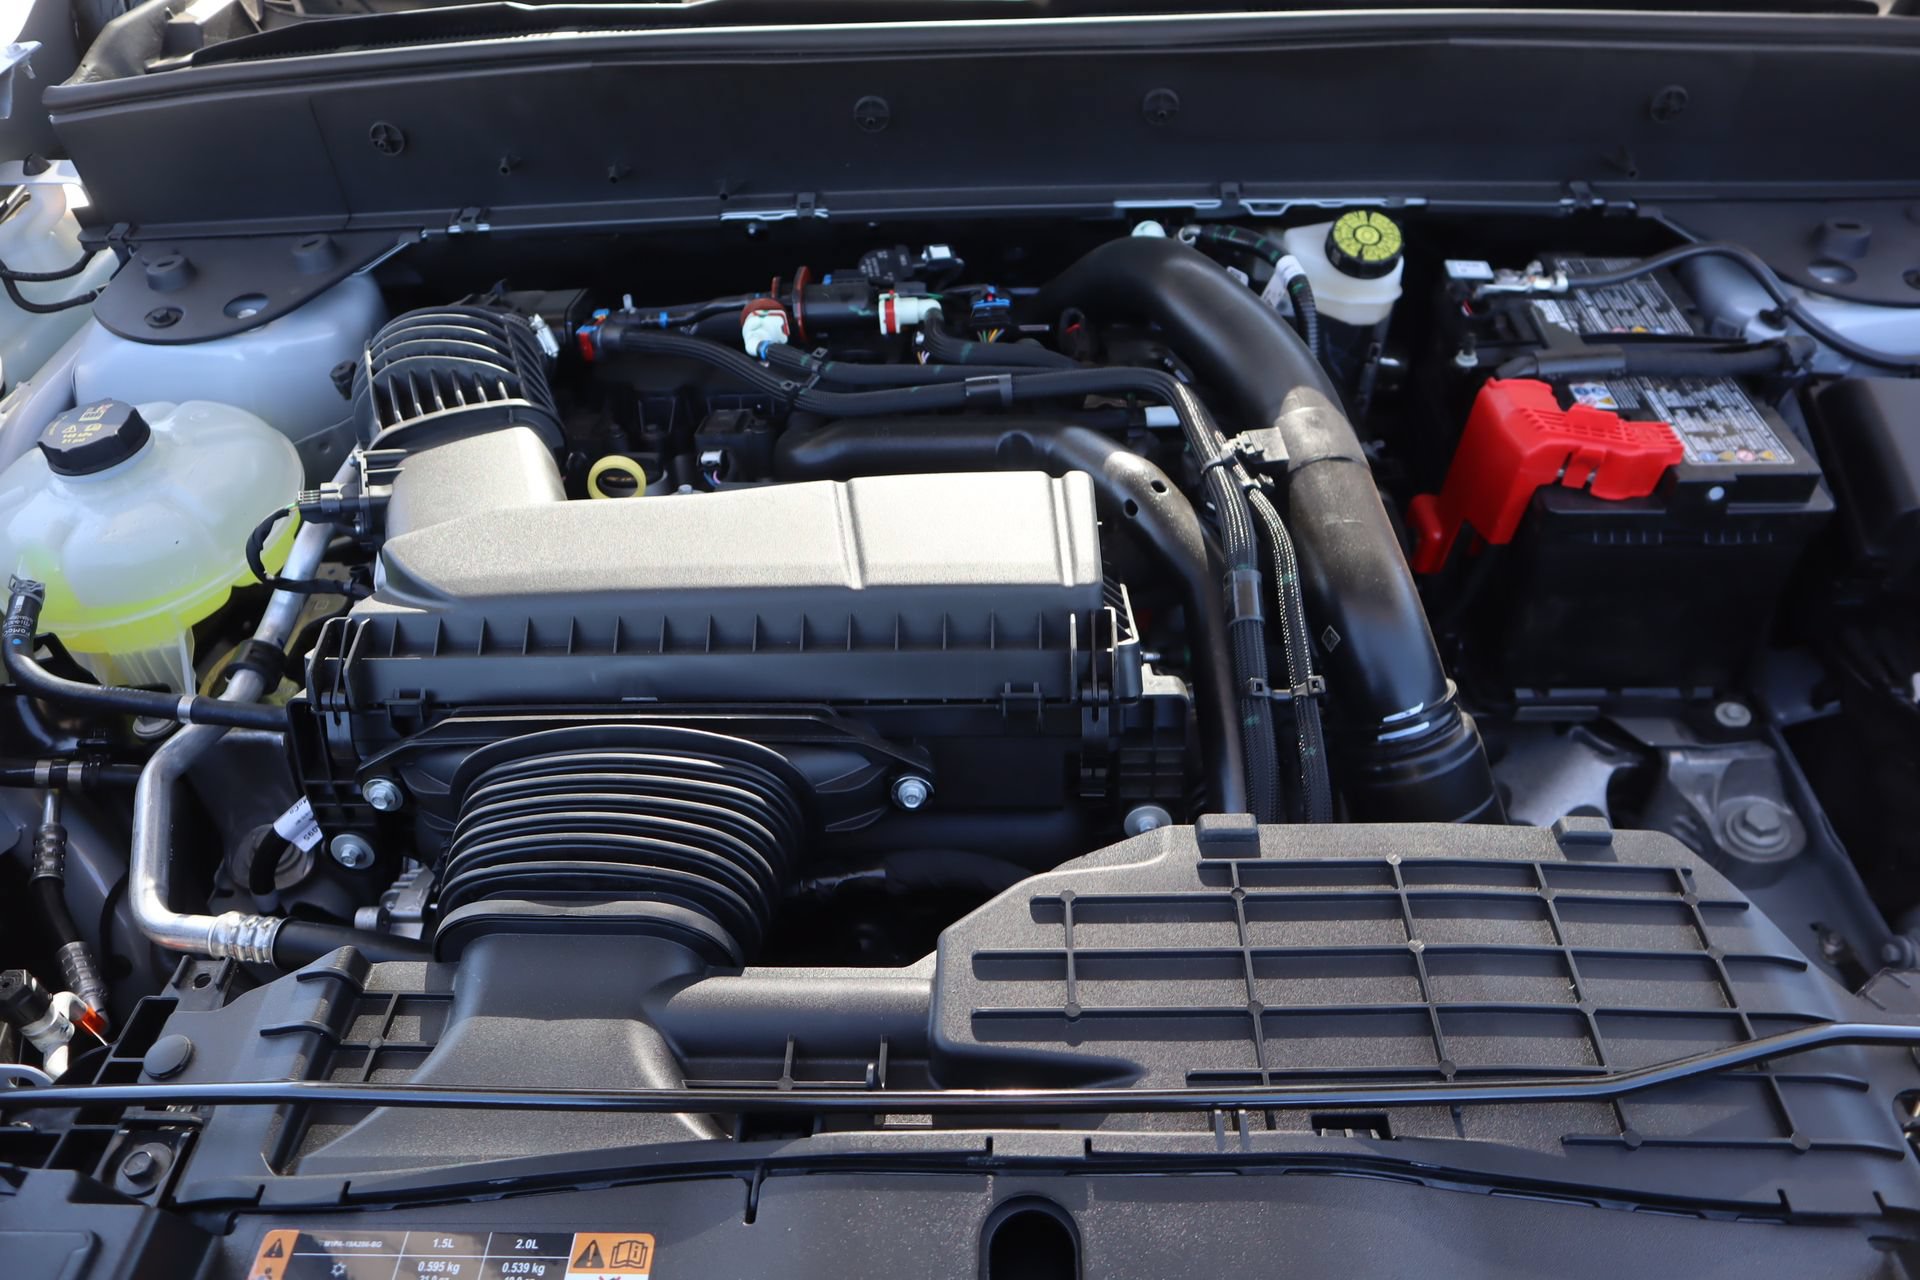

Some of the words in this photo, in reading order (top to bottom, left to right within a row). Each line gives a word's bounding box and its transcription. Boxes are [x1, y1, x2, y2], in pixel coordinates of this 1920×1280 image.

[433, 1238, 454, 1248] 1.5L
[515, 1239, 538, 1249] 2.0L
[417, 1261, 445, 1272] 0.595
[446, 1261, 460, 1274] kg
[501, 1262, 529, 1273] 0.539
[531, 1262, 545, 1276] kg
